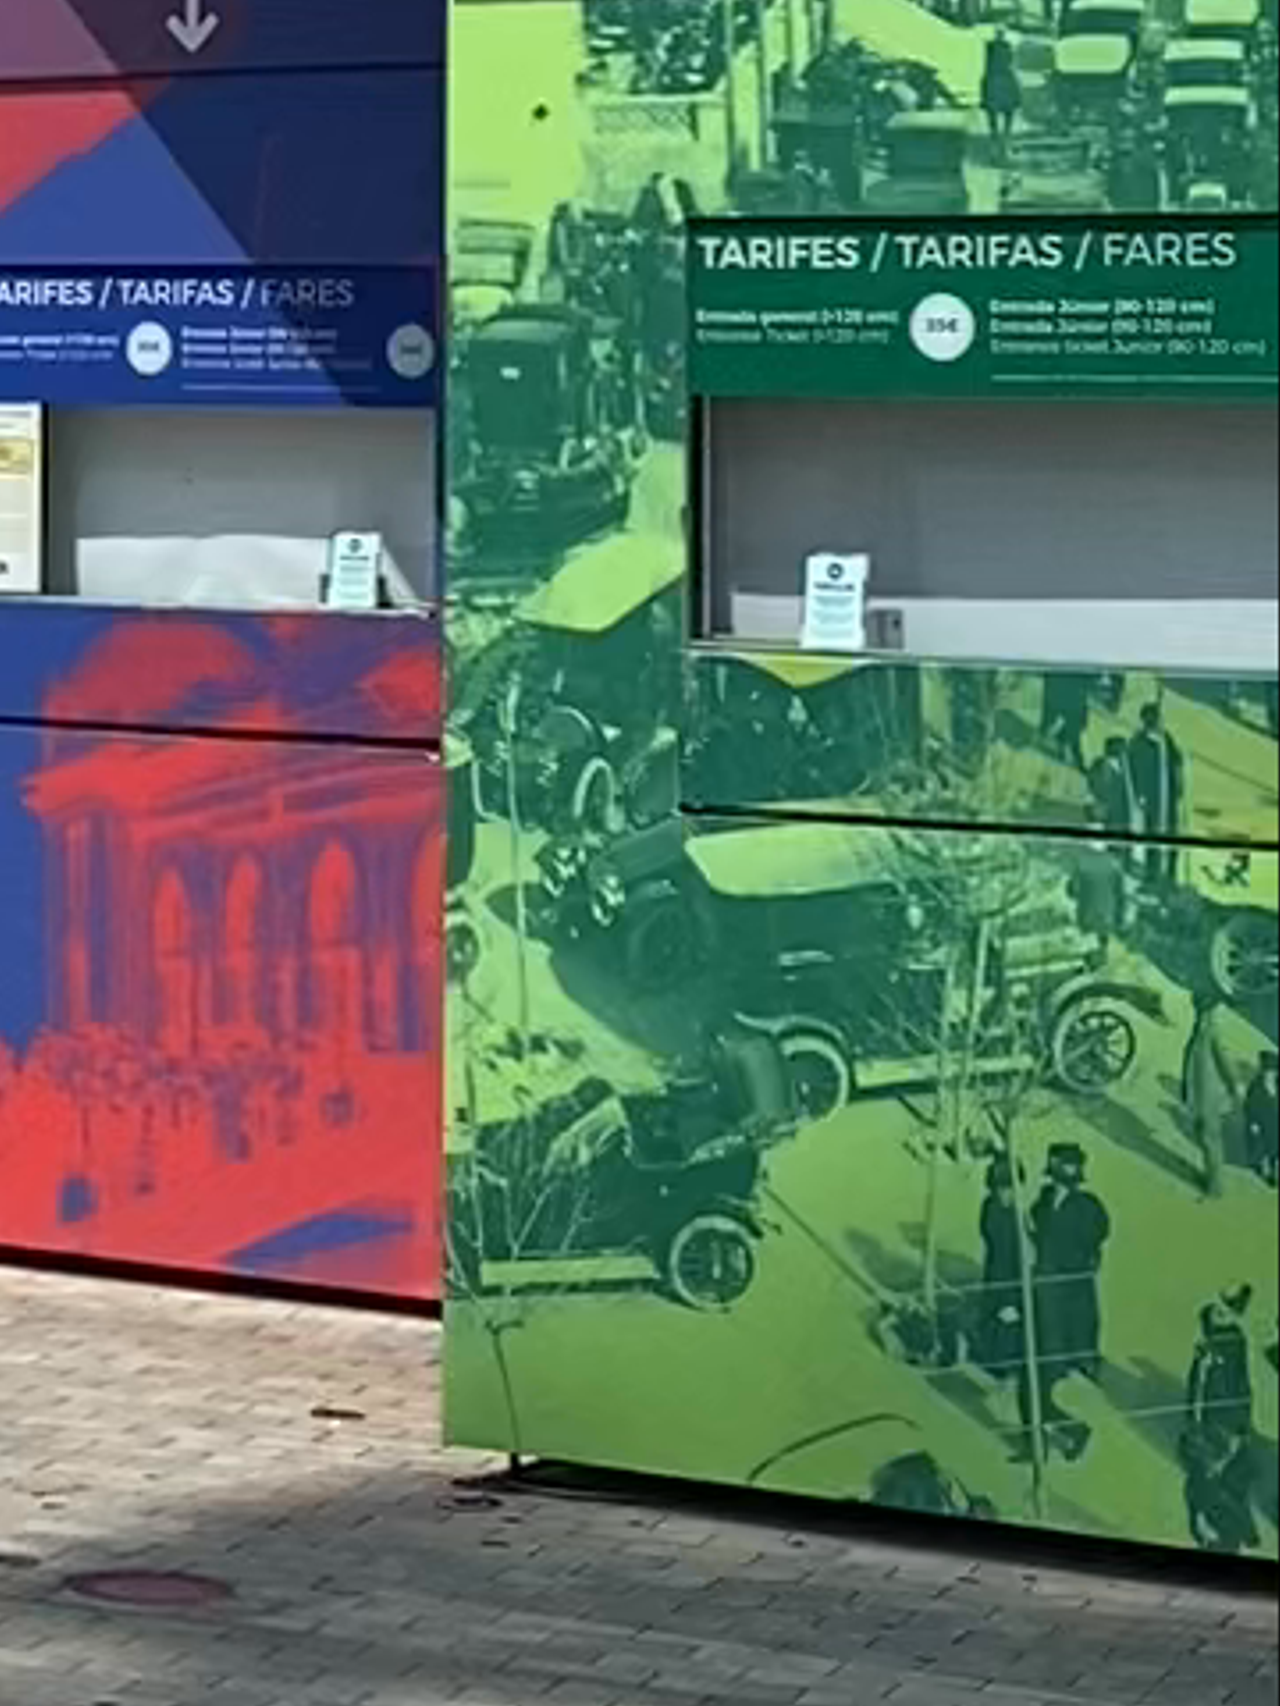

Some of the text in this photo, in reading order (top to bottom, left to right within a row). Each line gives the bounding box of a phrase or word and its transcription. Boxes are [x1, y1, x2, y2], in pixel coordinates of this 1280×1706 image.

[698, 230, 1237, 273] TARIFES / TARIFAS / FARES
[119, 279, 234, 306] TARIFAS
[261, 279, 354, 306] FARES
